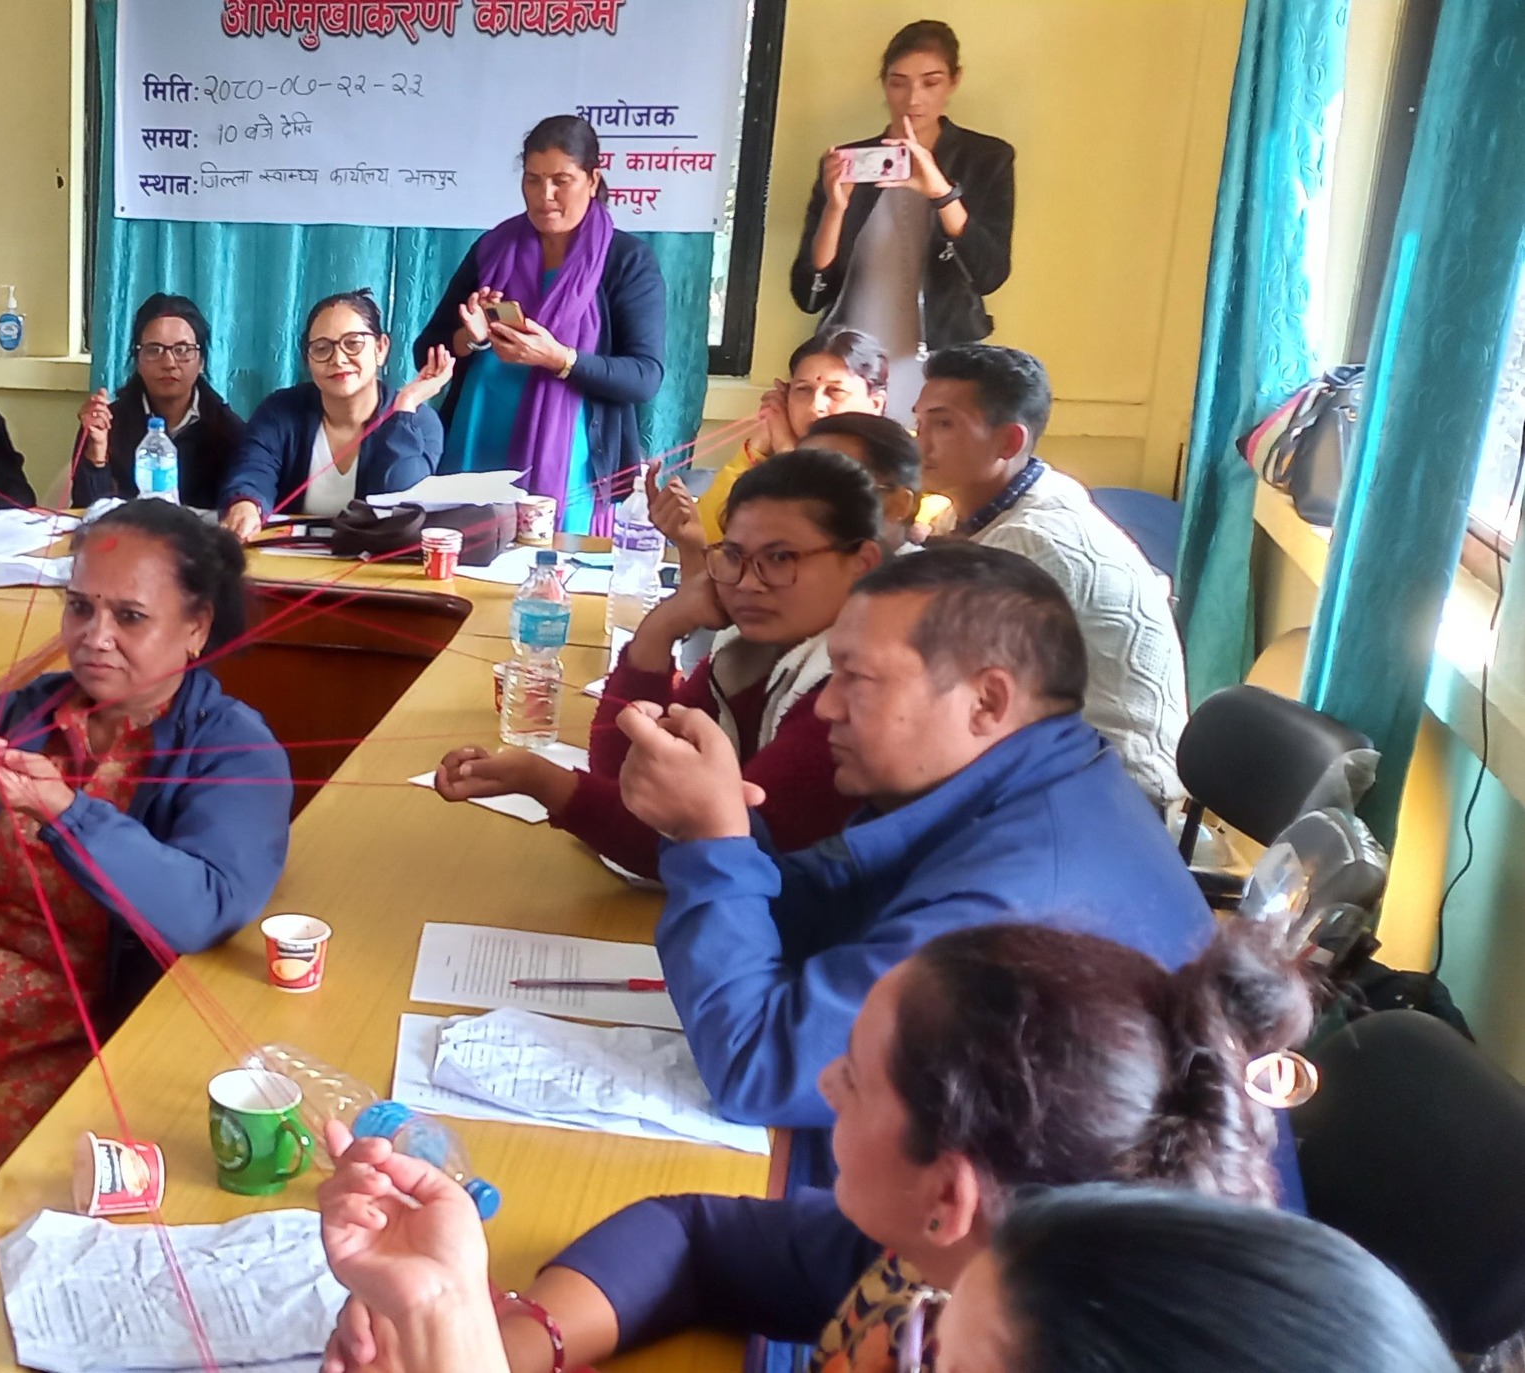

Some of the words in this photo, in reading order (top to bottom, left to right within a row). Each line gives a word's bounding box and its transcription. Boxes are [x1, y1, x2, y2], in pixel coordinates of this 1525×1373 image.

[576, 99, 679, 127] आयोजक
[141, 127, 199, 150] समय:
[626, 146, 717, 174] कार्यालय
[138, 174, 198, 197] स्थान:
[607, 187, 662, 215] क्तपुर
